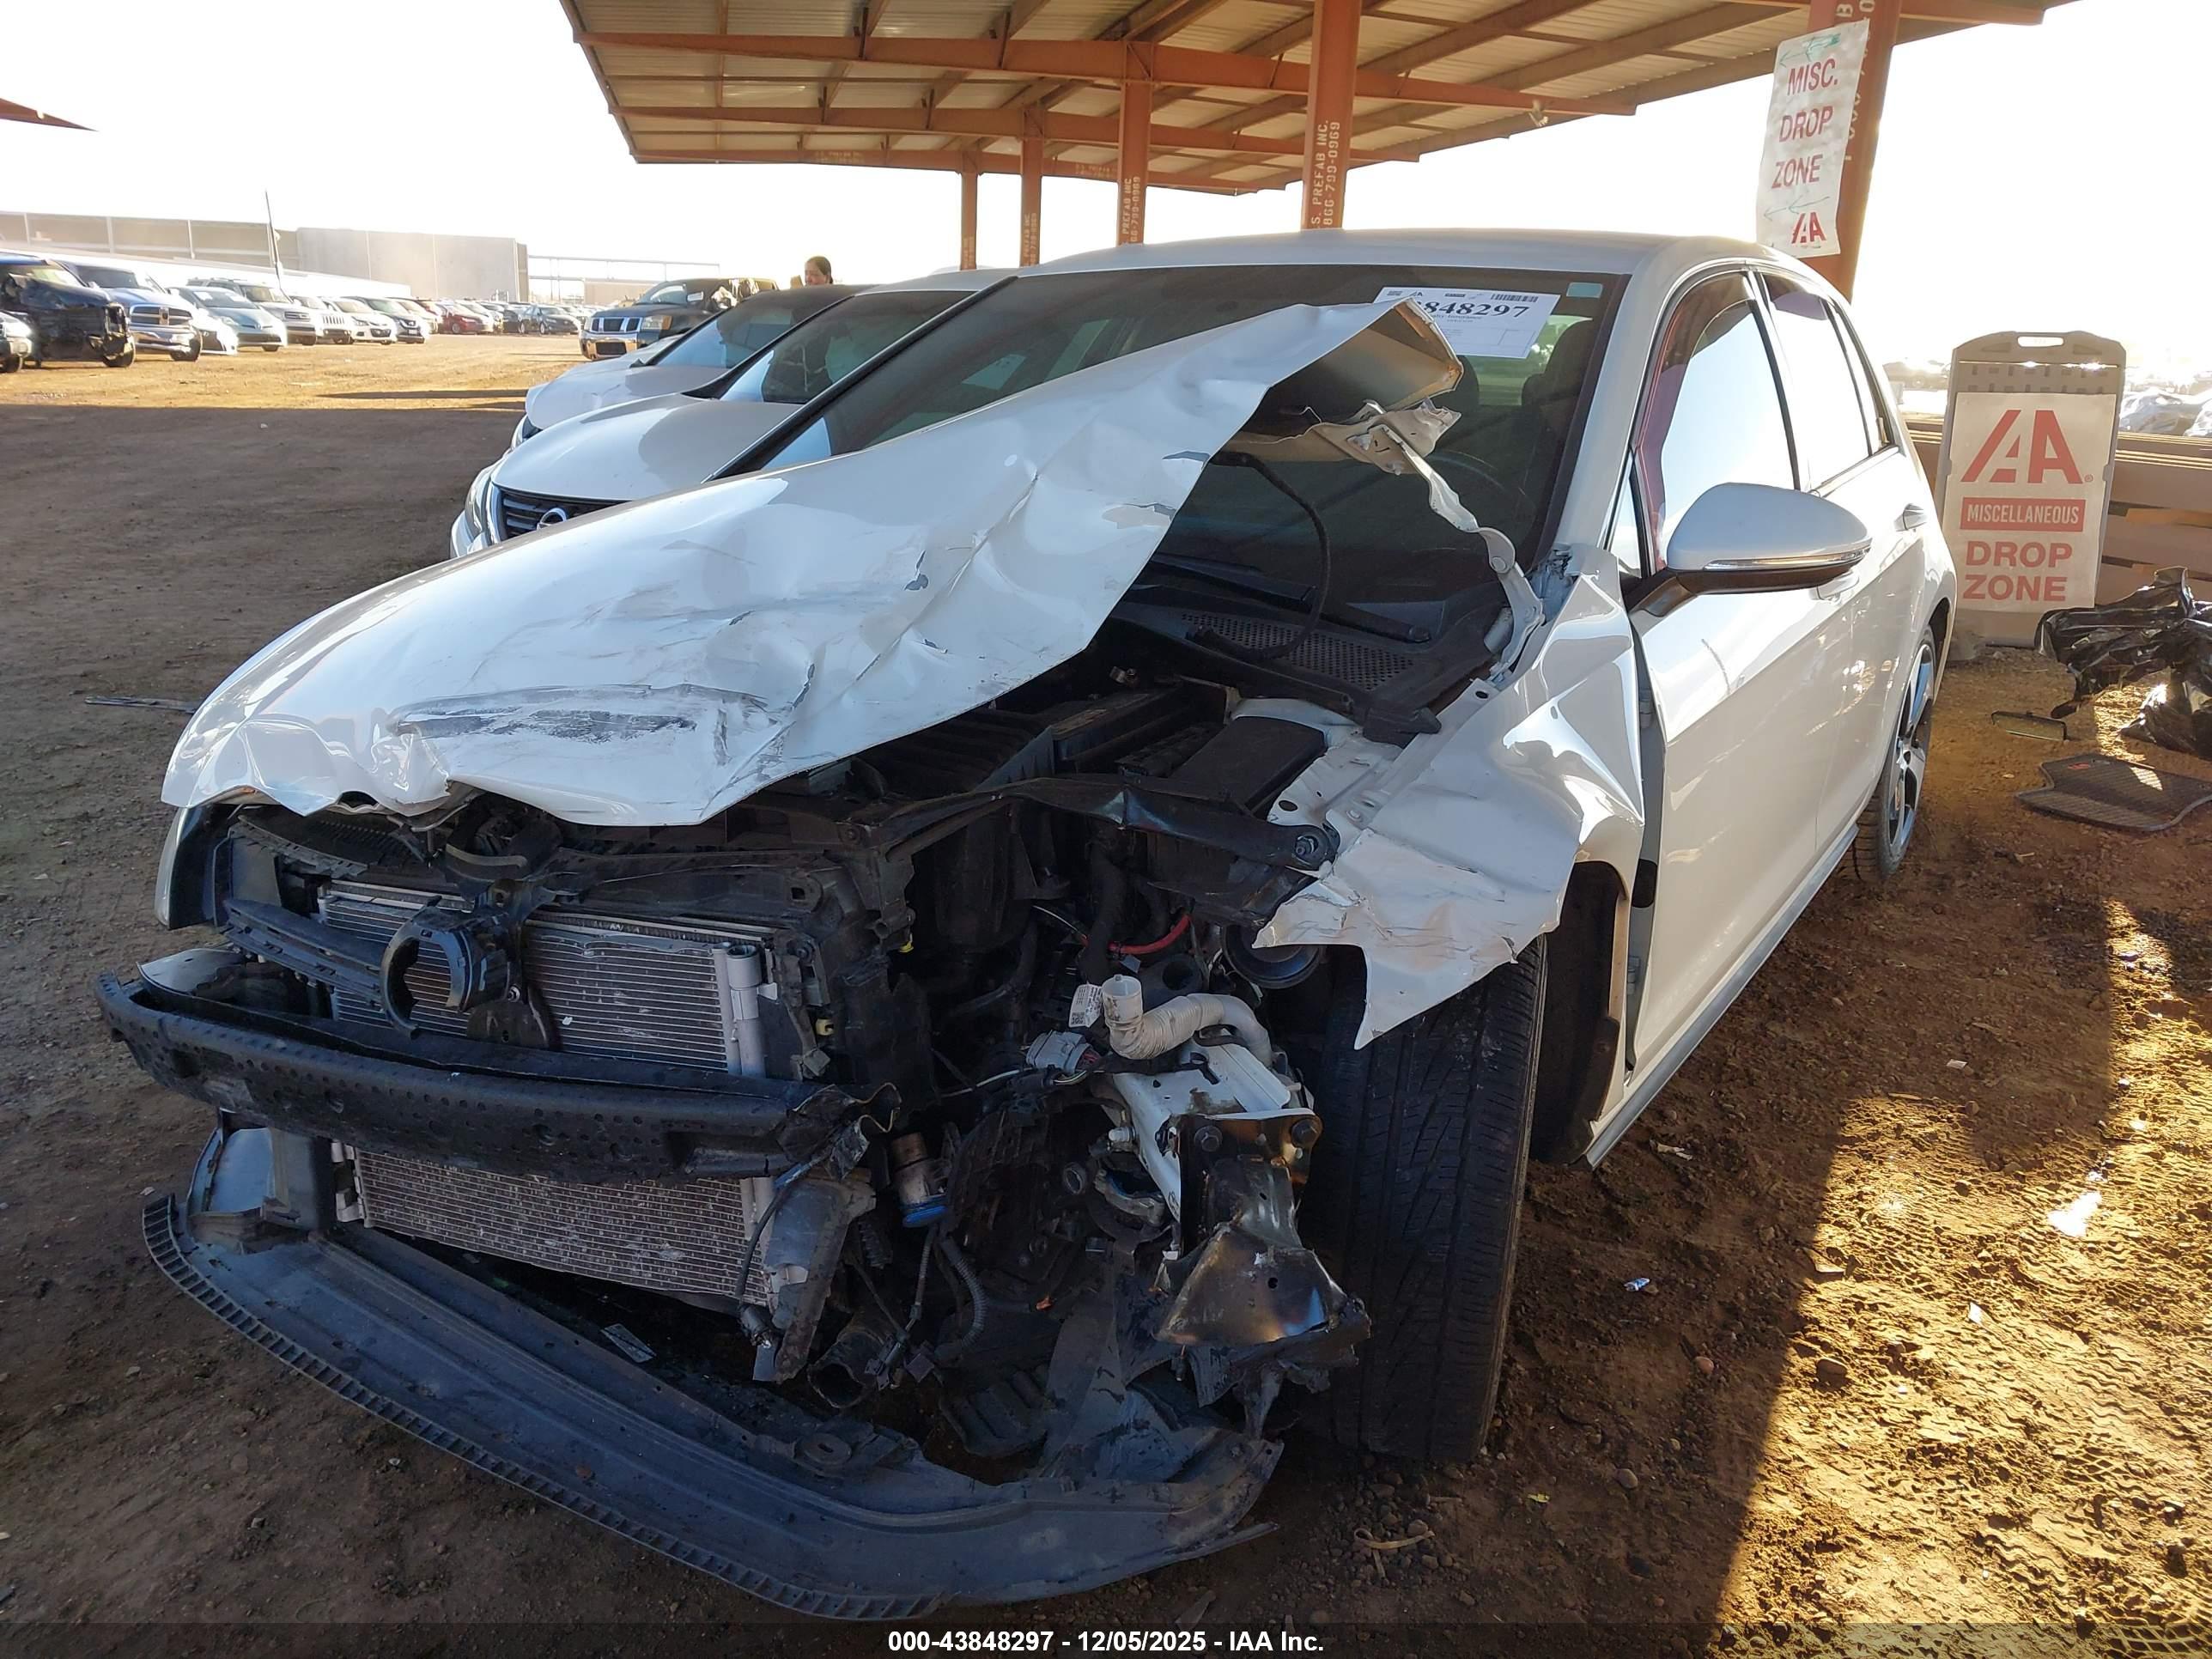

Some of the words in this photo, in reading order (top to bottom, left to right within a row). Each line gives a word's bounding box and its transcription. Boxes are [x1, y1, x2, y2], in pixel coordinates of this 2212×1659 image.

[1787, 58, 1838, 96] MISC.
[1316, 119, 1329, 147] INC.
[1778, 105, 1834, 143] DROP
[1312, 152, 1326, 206] PREFAB
[1771, 154, 1824, 190] ZONE
[1417, 301, 1530, 319] 848297
[1966, 503, 2080, 525] MISCELLANEOUS
[1966, 540, 2073, 568] DROP
[1962, 574, 2068, 602] ZONE
